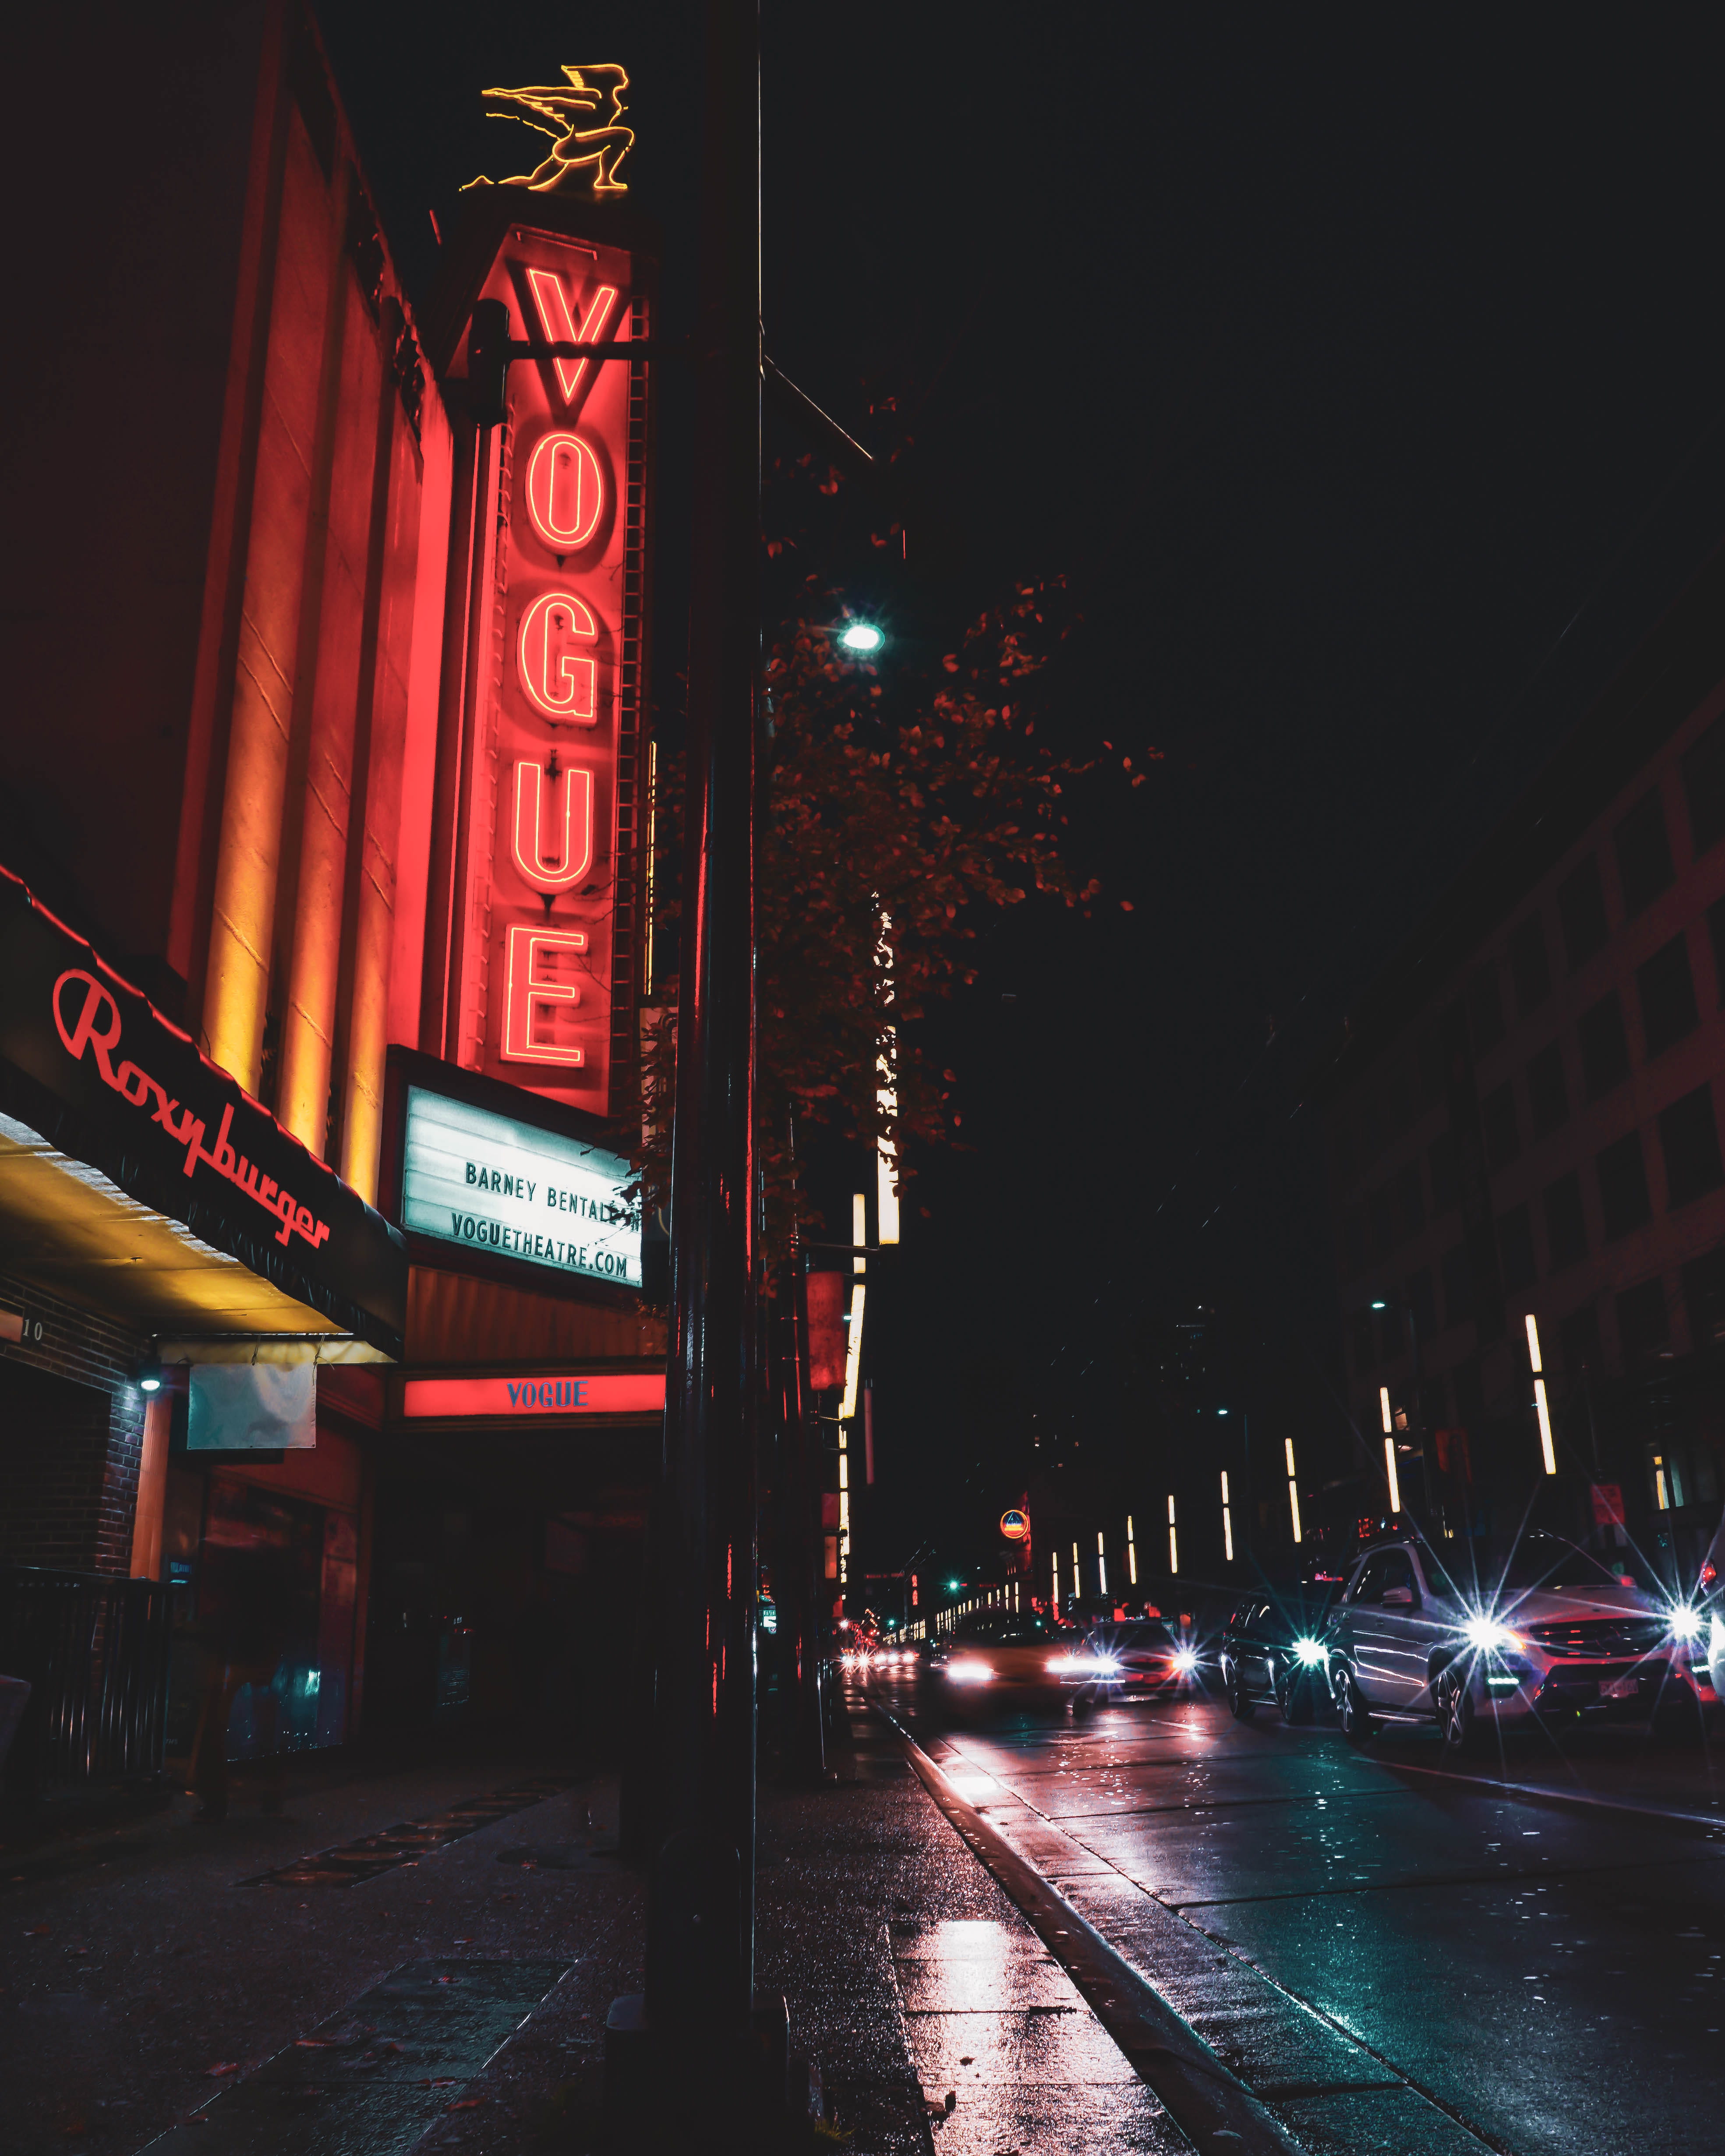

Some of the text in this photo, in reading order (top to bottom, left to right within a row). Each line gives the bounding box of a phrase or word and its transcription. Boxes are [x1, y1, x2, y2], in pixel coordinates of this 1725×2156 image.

[502, 265, 618, 1066] VOGUE
[52, 968, 330, 1248] Roxyburger
[466, 1162, 536, 1201] BARNEY
[452, 1212, 627, 1278] VOGUETHEATRE.COM
[507, 1380, 589, 1408] VOGUE
